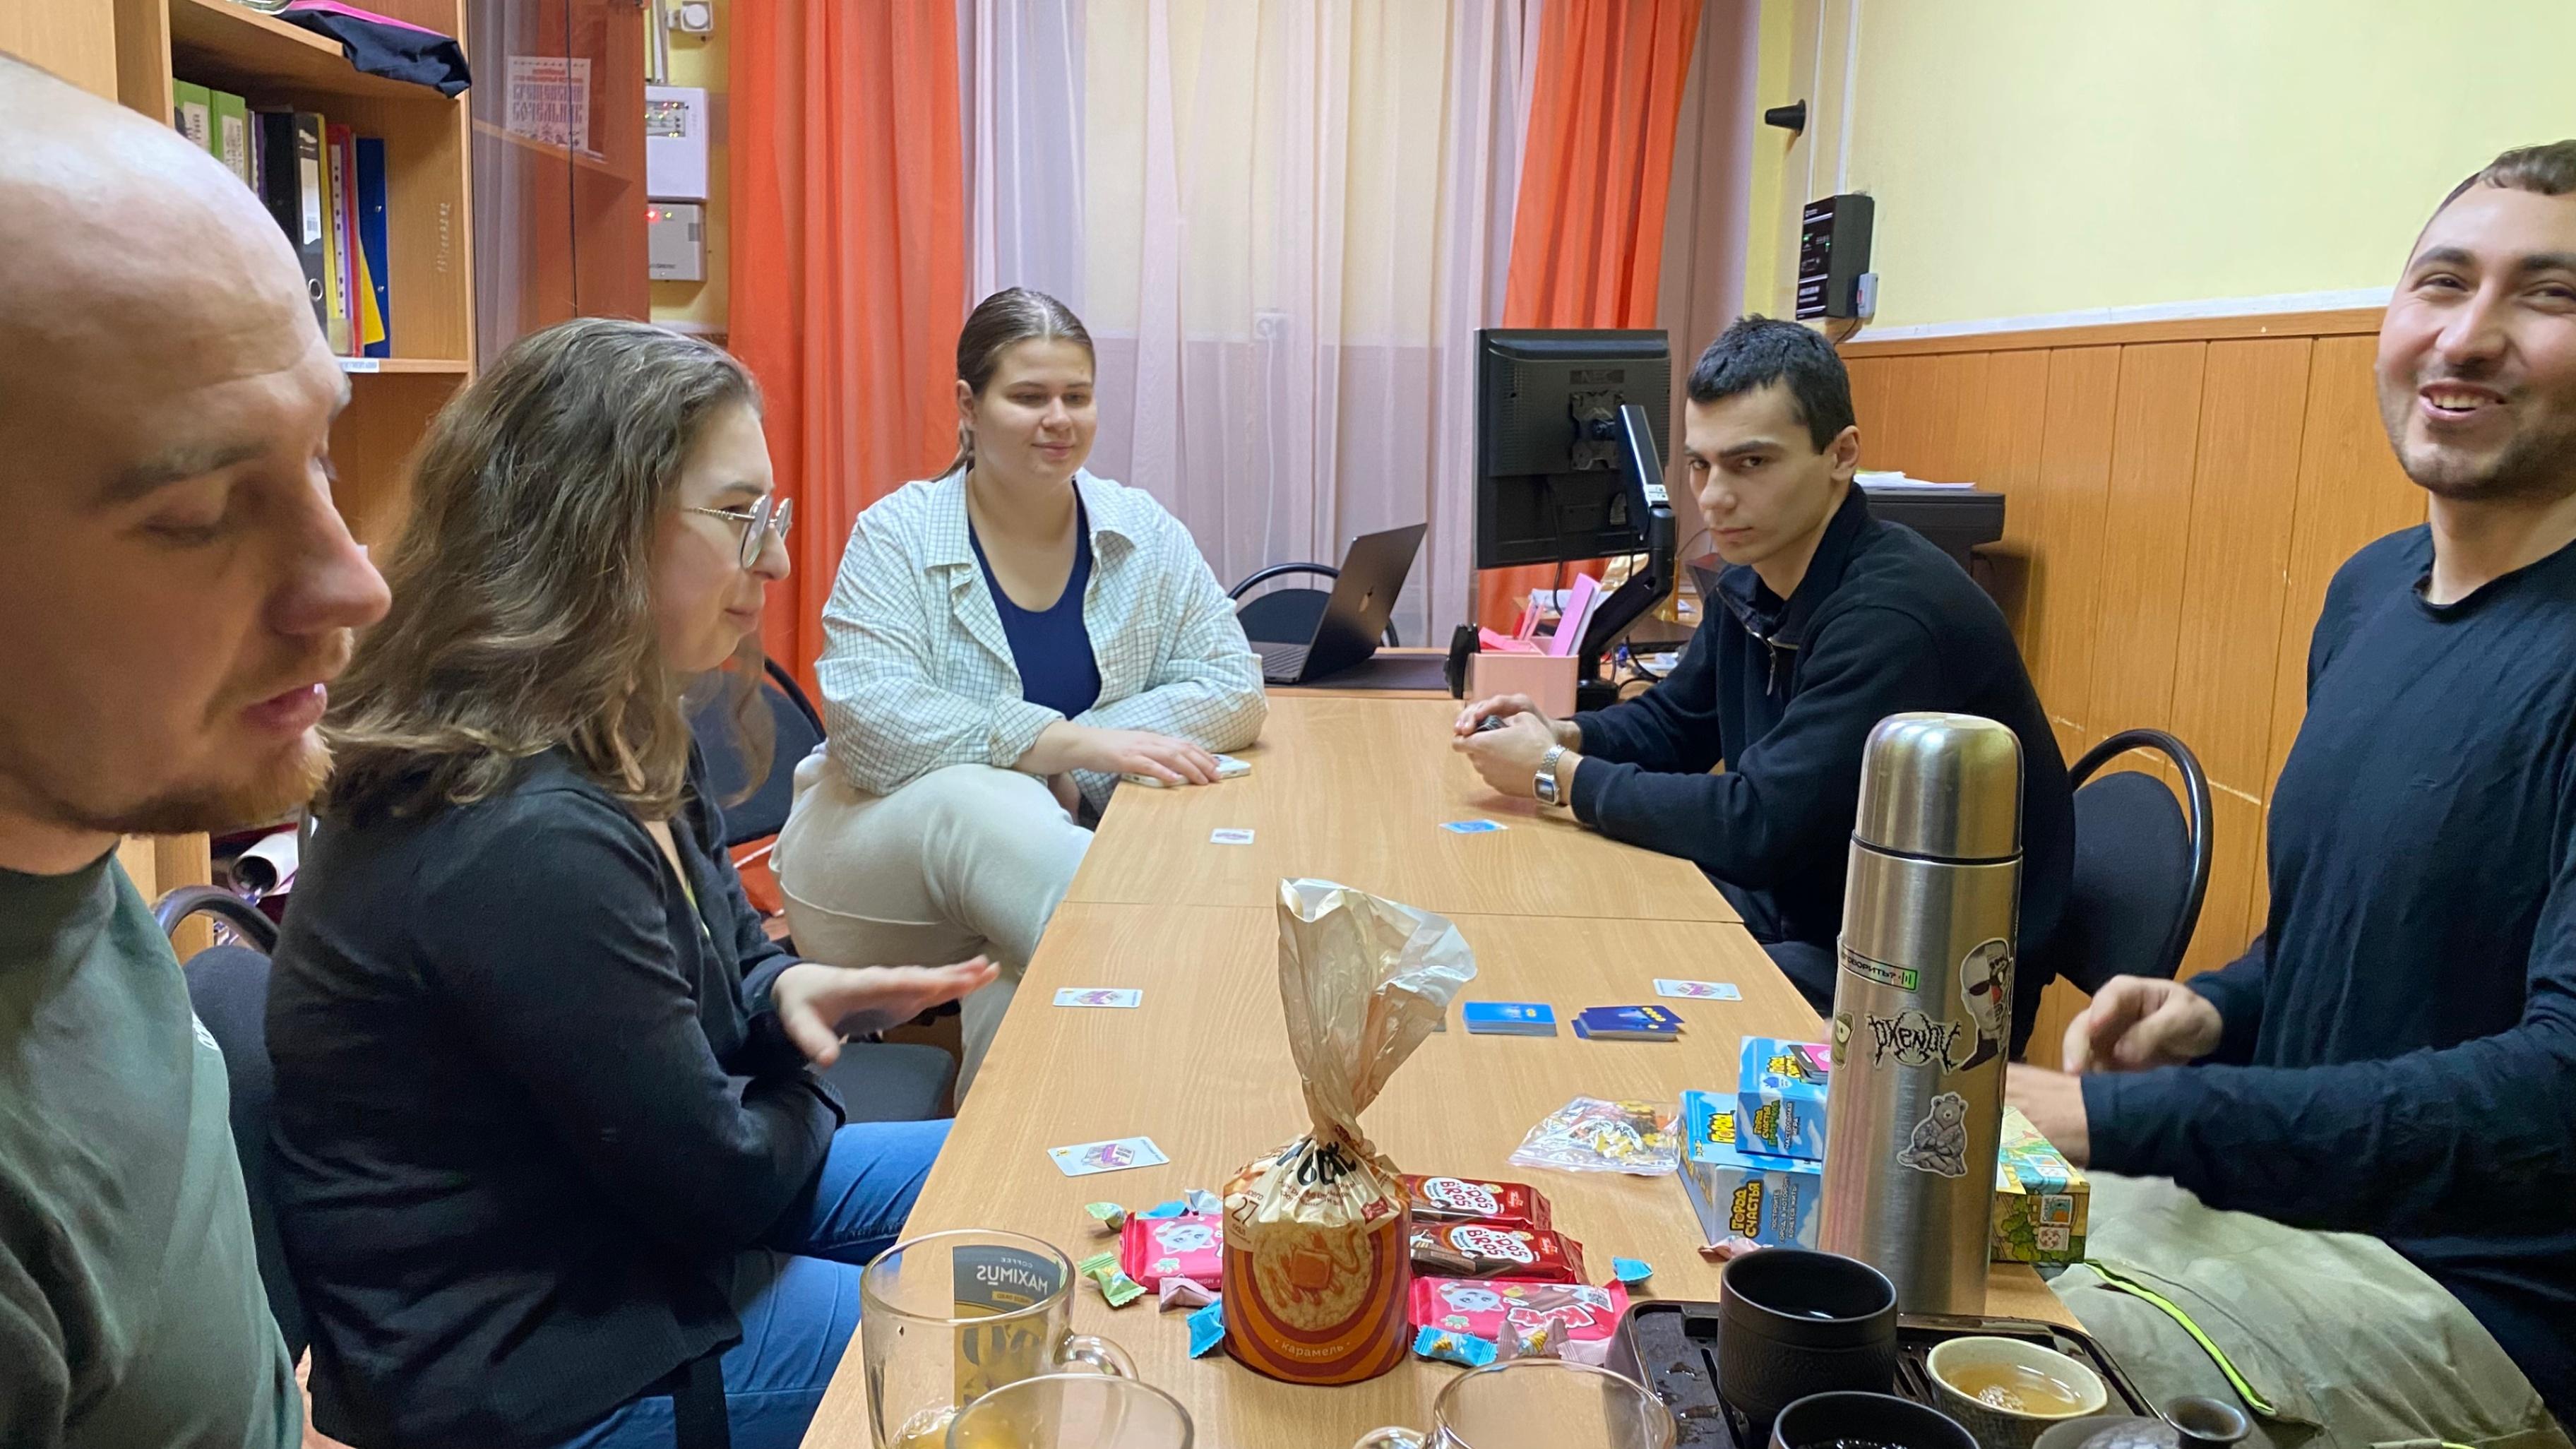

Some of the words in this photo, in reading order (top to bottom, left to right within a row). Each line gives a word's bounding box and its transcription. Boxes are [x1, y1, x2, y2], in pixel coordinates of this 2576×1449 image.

[1784, 1102, 1794, 1149] НАСТОЛЬНАЯ
[1232, 1197, 1260, 1225] 27
[1731, 1189, 1747, 1230] ГОРОД
[1745, 1181, 1761, 1238] СЧАСТЬЯ
[1281, 1342, 1344, 1357] карамель
